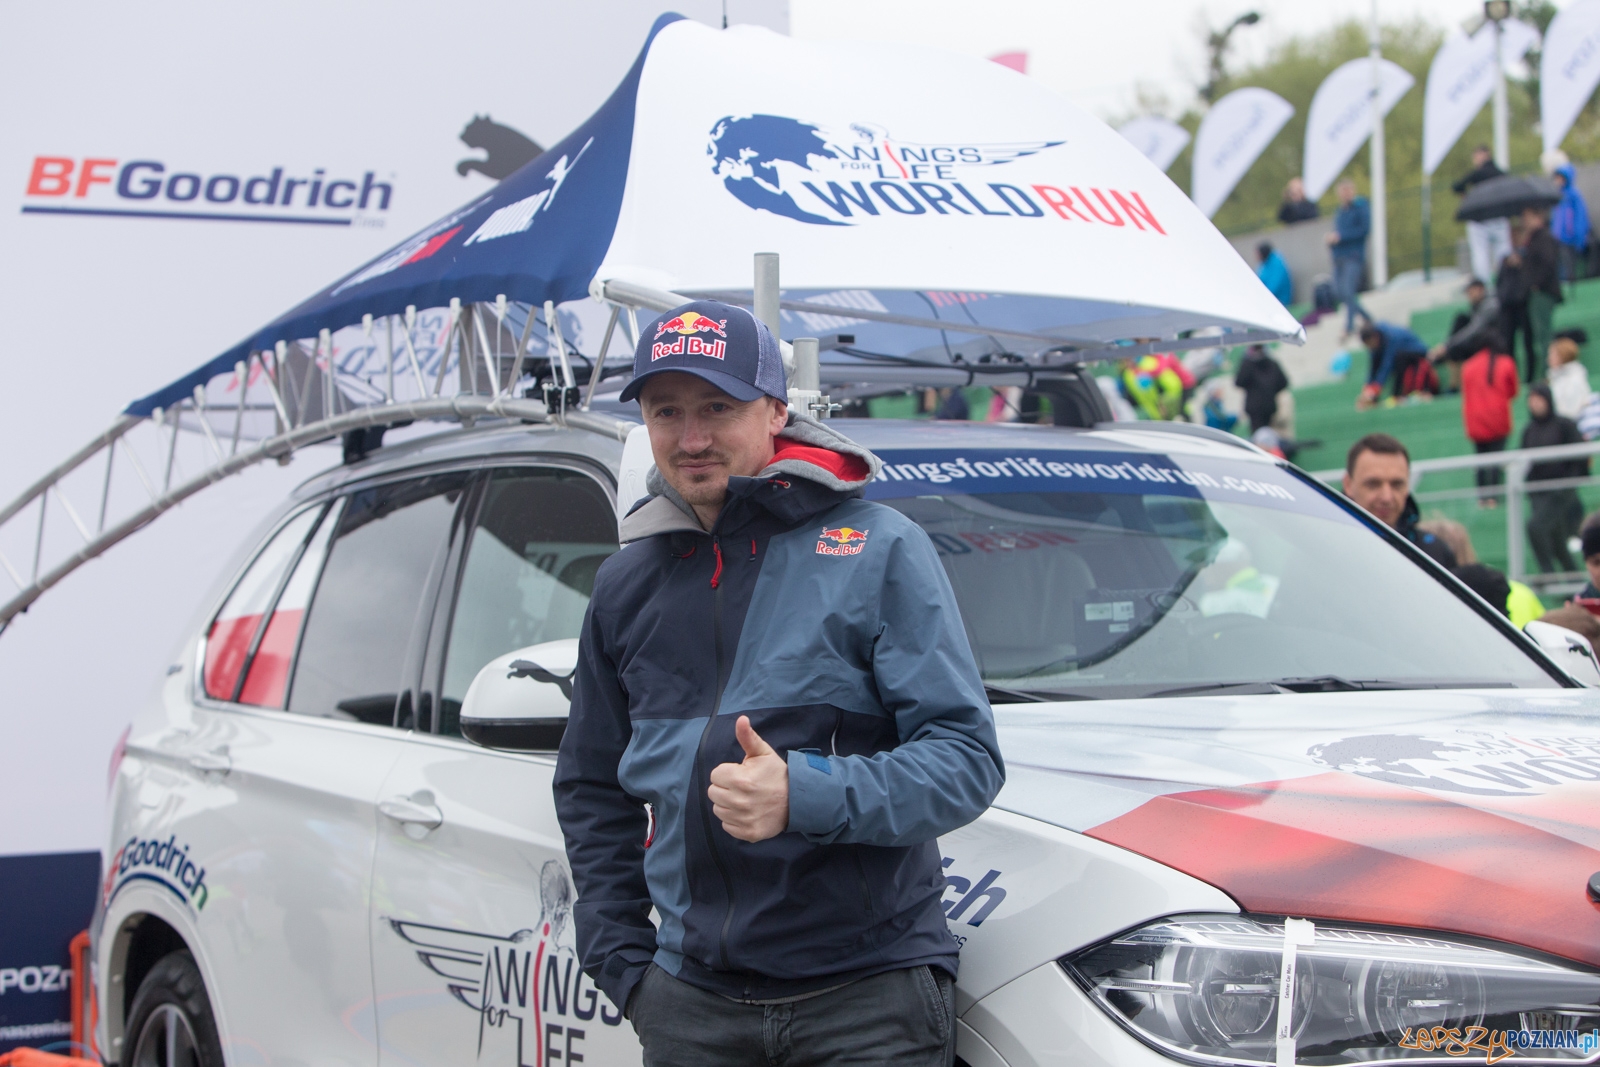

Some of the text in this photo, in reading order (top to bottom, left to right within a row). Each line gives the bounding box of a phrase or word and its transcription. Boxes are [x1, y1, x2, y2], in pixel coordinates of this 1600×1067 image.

[833, 141, 982, 164] WINGS
[25, 155, 394, 210] BFGoodrich
[841, 162, 957, 181] FOR LIFE
[652, 336, 726, 362] Red Bull
[815, 540, 866, 557] Red Bull
